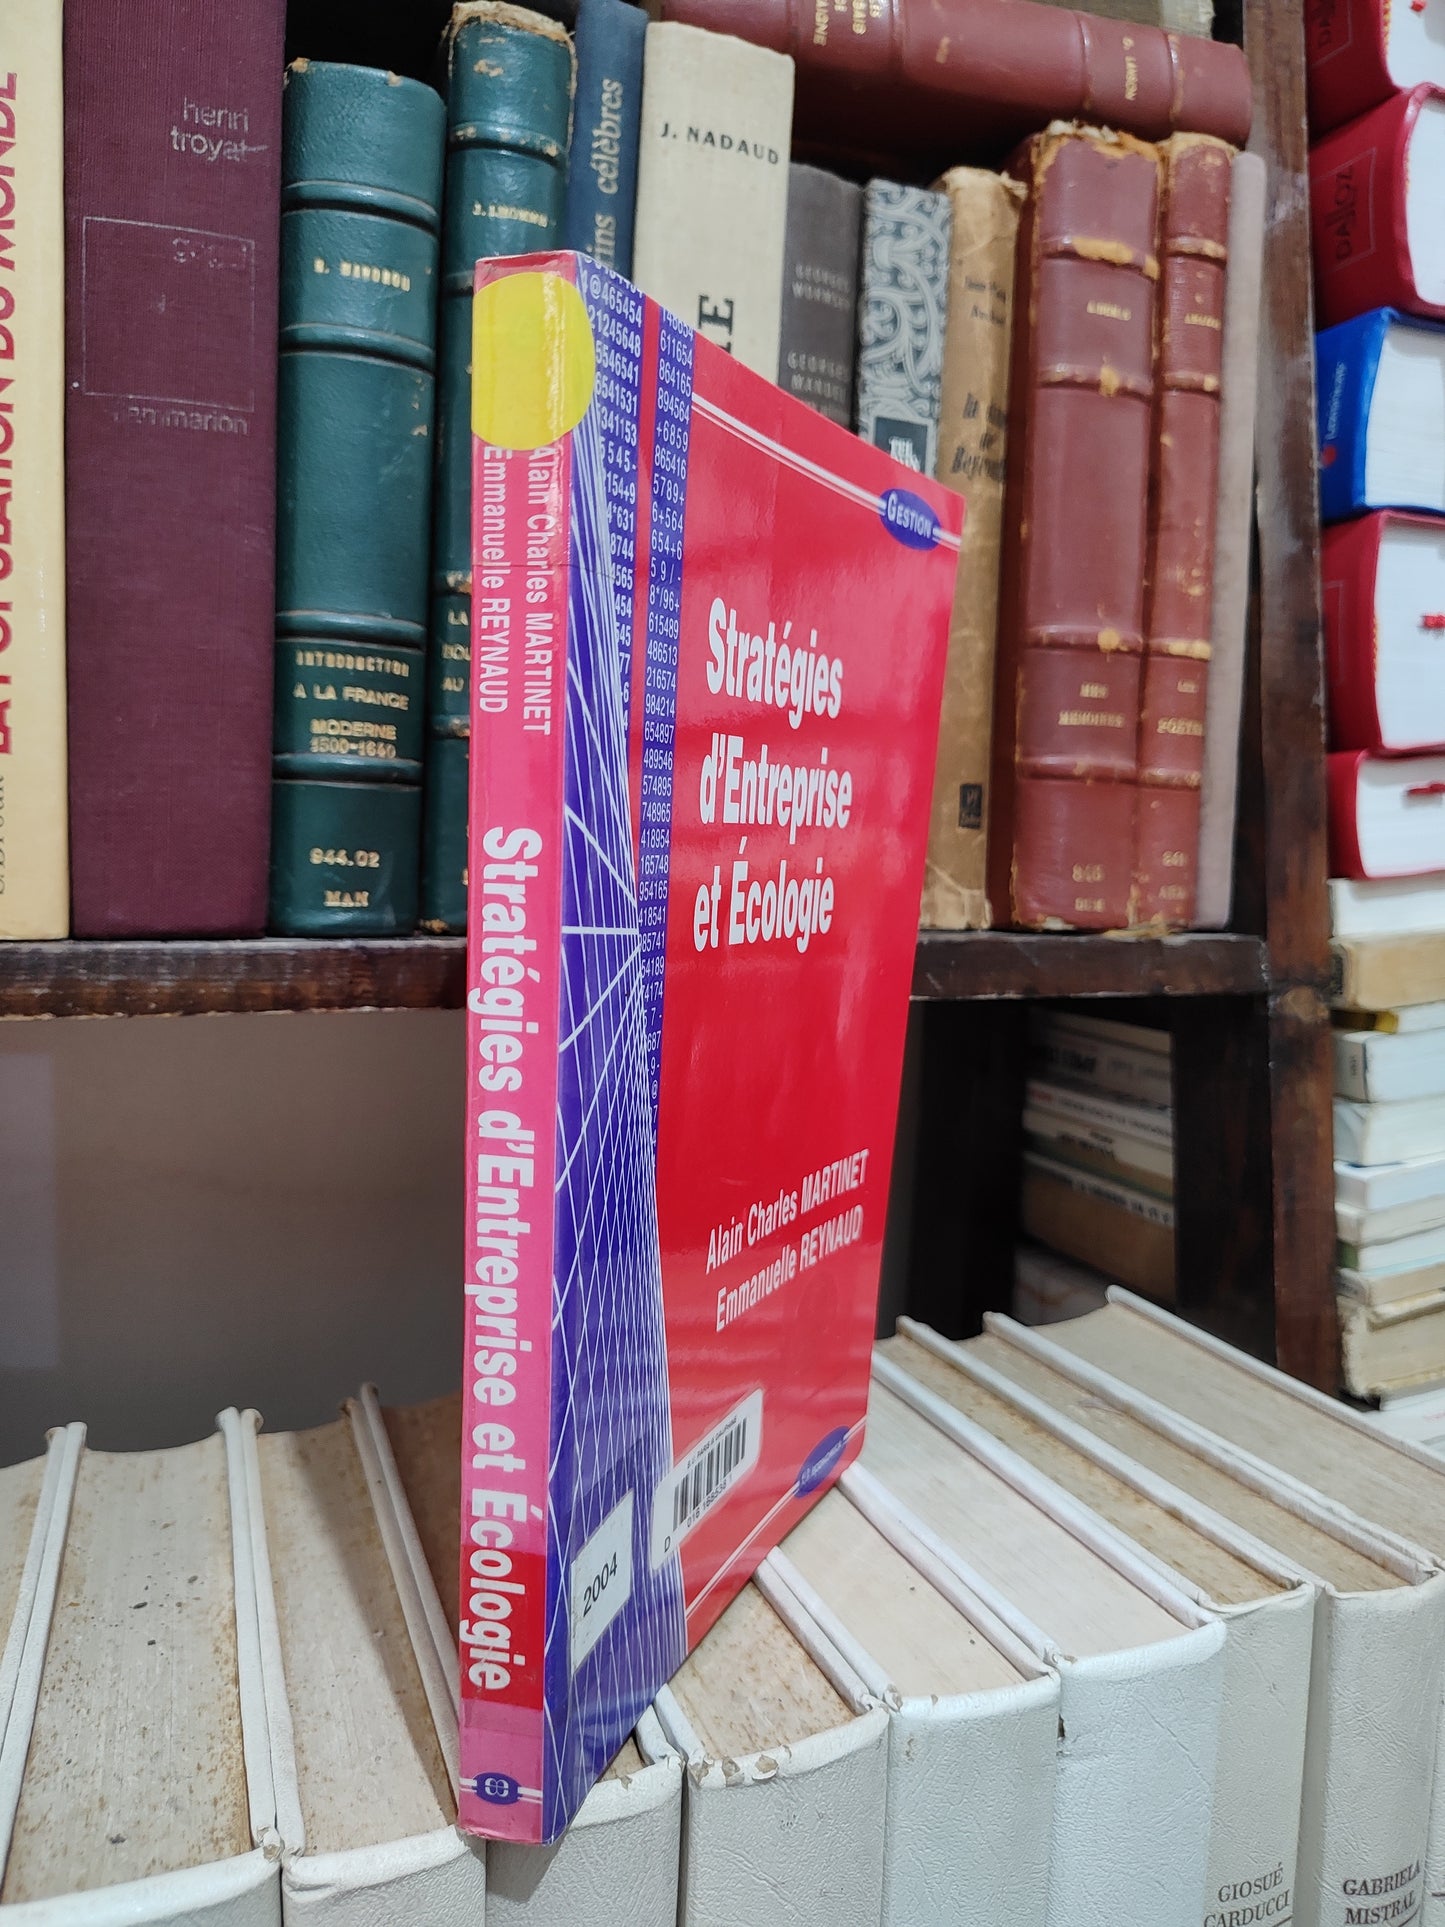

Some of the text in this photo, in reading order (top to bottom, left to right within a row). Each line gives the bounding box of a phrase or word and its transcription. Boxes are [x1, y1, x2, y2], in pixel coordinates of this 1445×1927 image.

[183, 97, 249, 132] henri
[591, 78, 623, 195] célèbres
[170, 126, 247, 162] troyat
[661, 123, 779, 165] J. NADAUD
[478, 446, 512, 714] Emmanuelle REYNAUD
[525, 513, 558, 604] Charles
[296, 650, 410, 677] INTRODUCTION
[522, 611, 554, 736] MARTINET
[705, 596, 844, 730] Stratégies
[313, 683, 337, 700] LA
[342, 685, 409, 711] FRANCE
[310, 718, 398, 741] MODERNE
[699, 732, 853, 845] d'Entreprise
[693, 835, 835, 954] et Écologie
[705, 1148, 869, 1275] Alain Charles MARTINET
[459, 825, 544, 1692] Stratégies d'Entreprise et Écologie
[715, 1203, 865, 1333] Emmanuelle REYNAUD
[664, 1535, 672, 1553] D
[583, 1551, 618, 1618] 2004
[1217, 1862, 1284, 1903] GIOSUÉ
[1342, 1860, 1422, 1896] GABRIELA
[1203, 1889, 1291, 1927] CARDUCCI
[1345, 1891, 1416, 1926] MISTRAL
